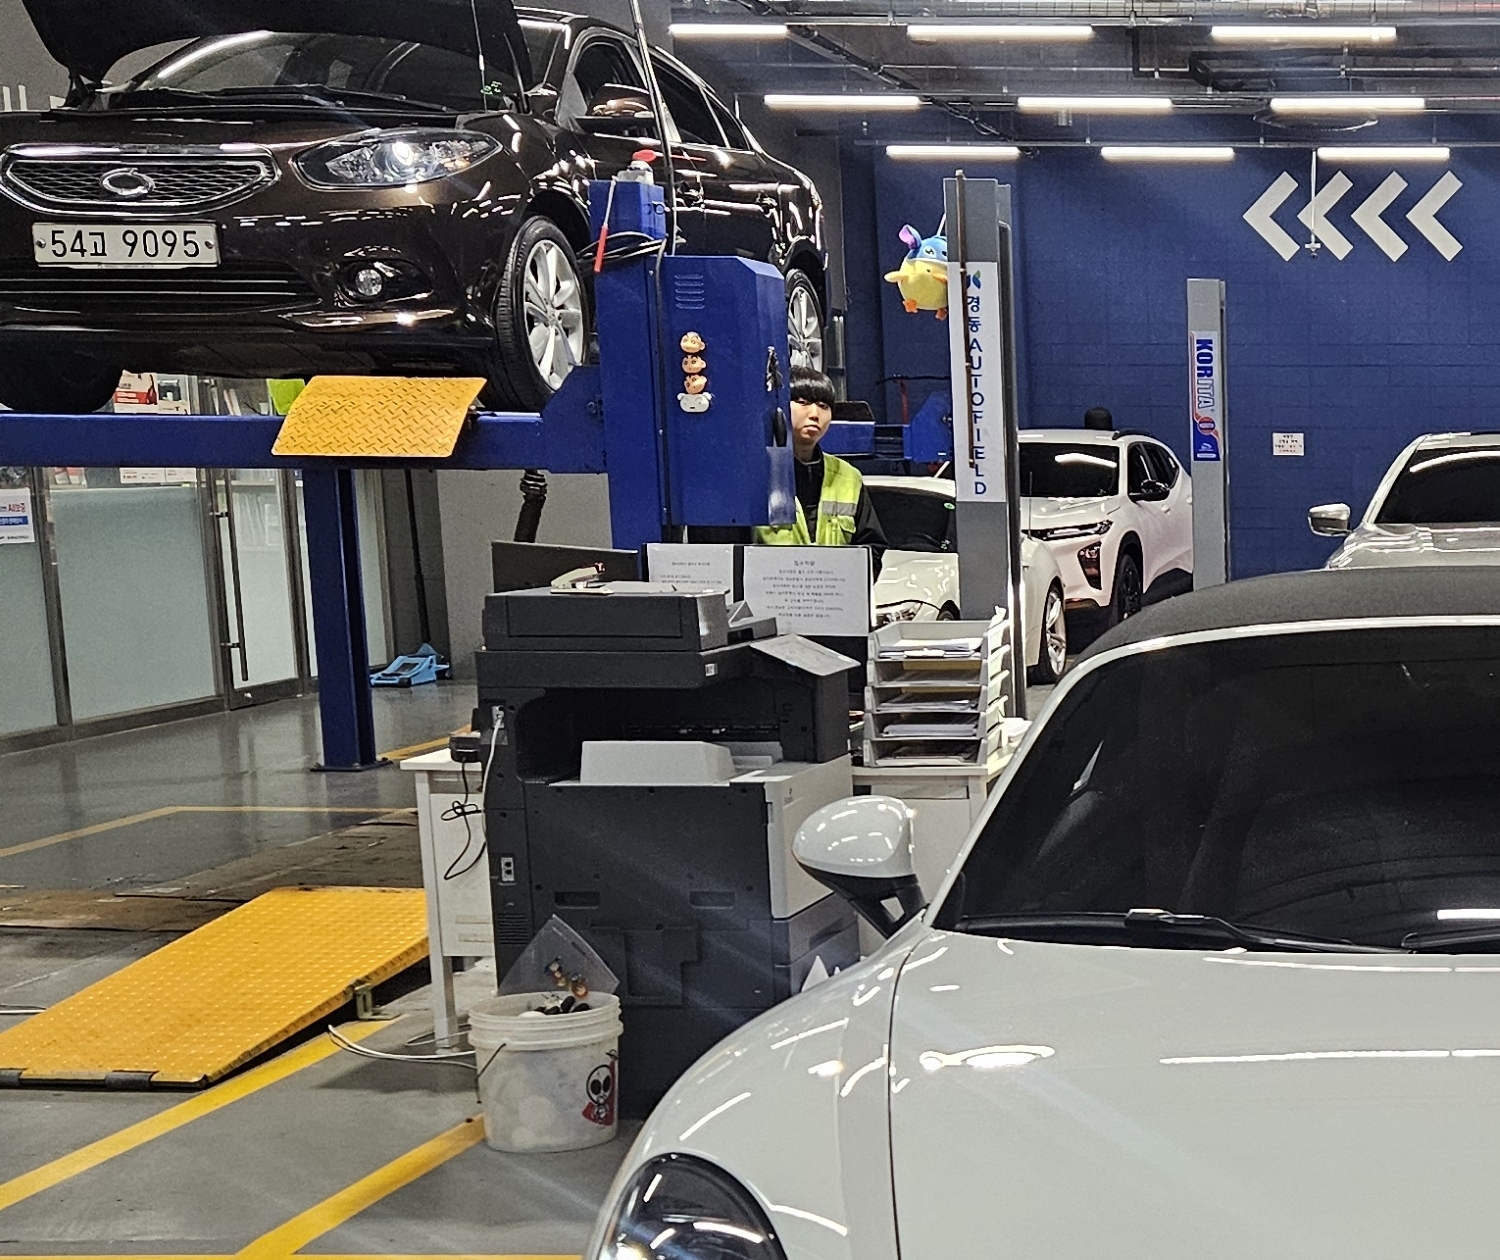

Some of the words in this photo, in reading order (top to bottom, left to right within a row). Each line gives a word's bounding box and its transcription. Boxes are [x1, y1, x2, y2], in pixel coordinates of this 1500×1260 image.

[51, 230, 107, 257] 54고
[122, 230, 199, 257] 9095
[1196, 339, 1214, 409] KORITA
